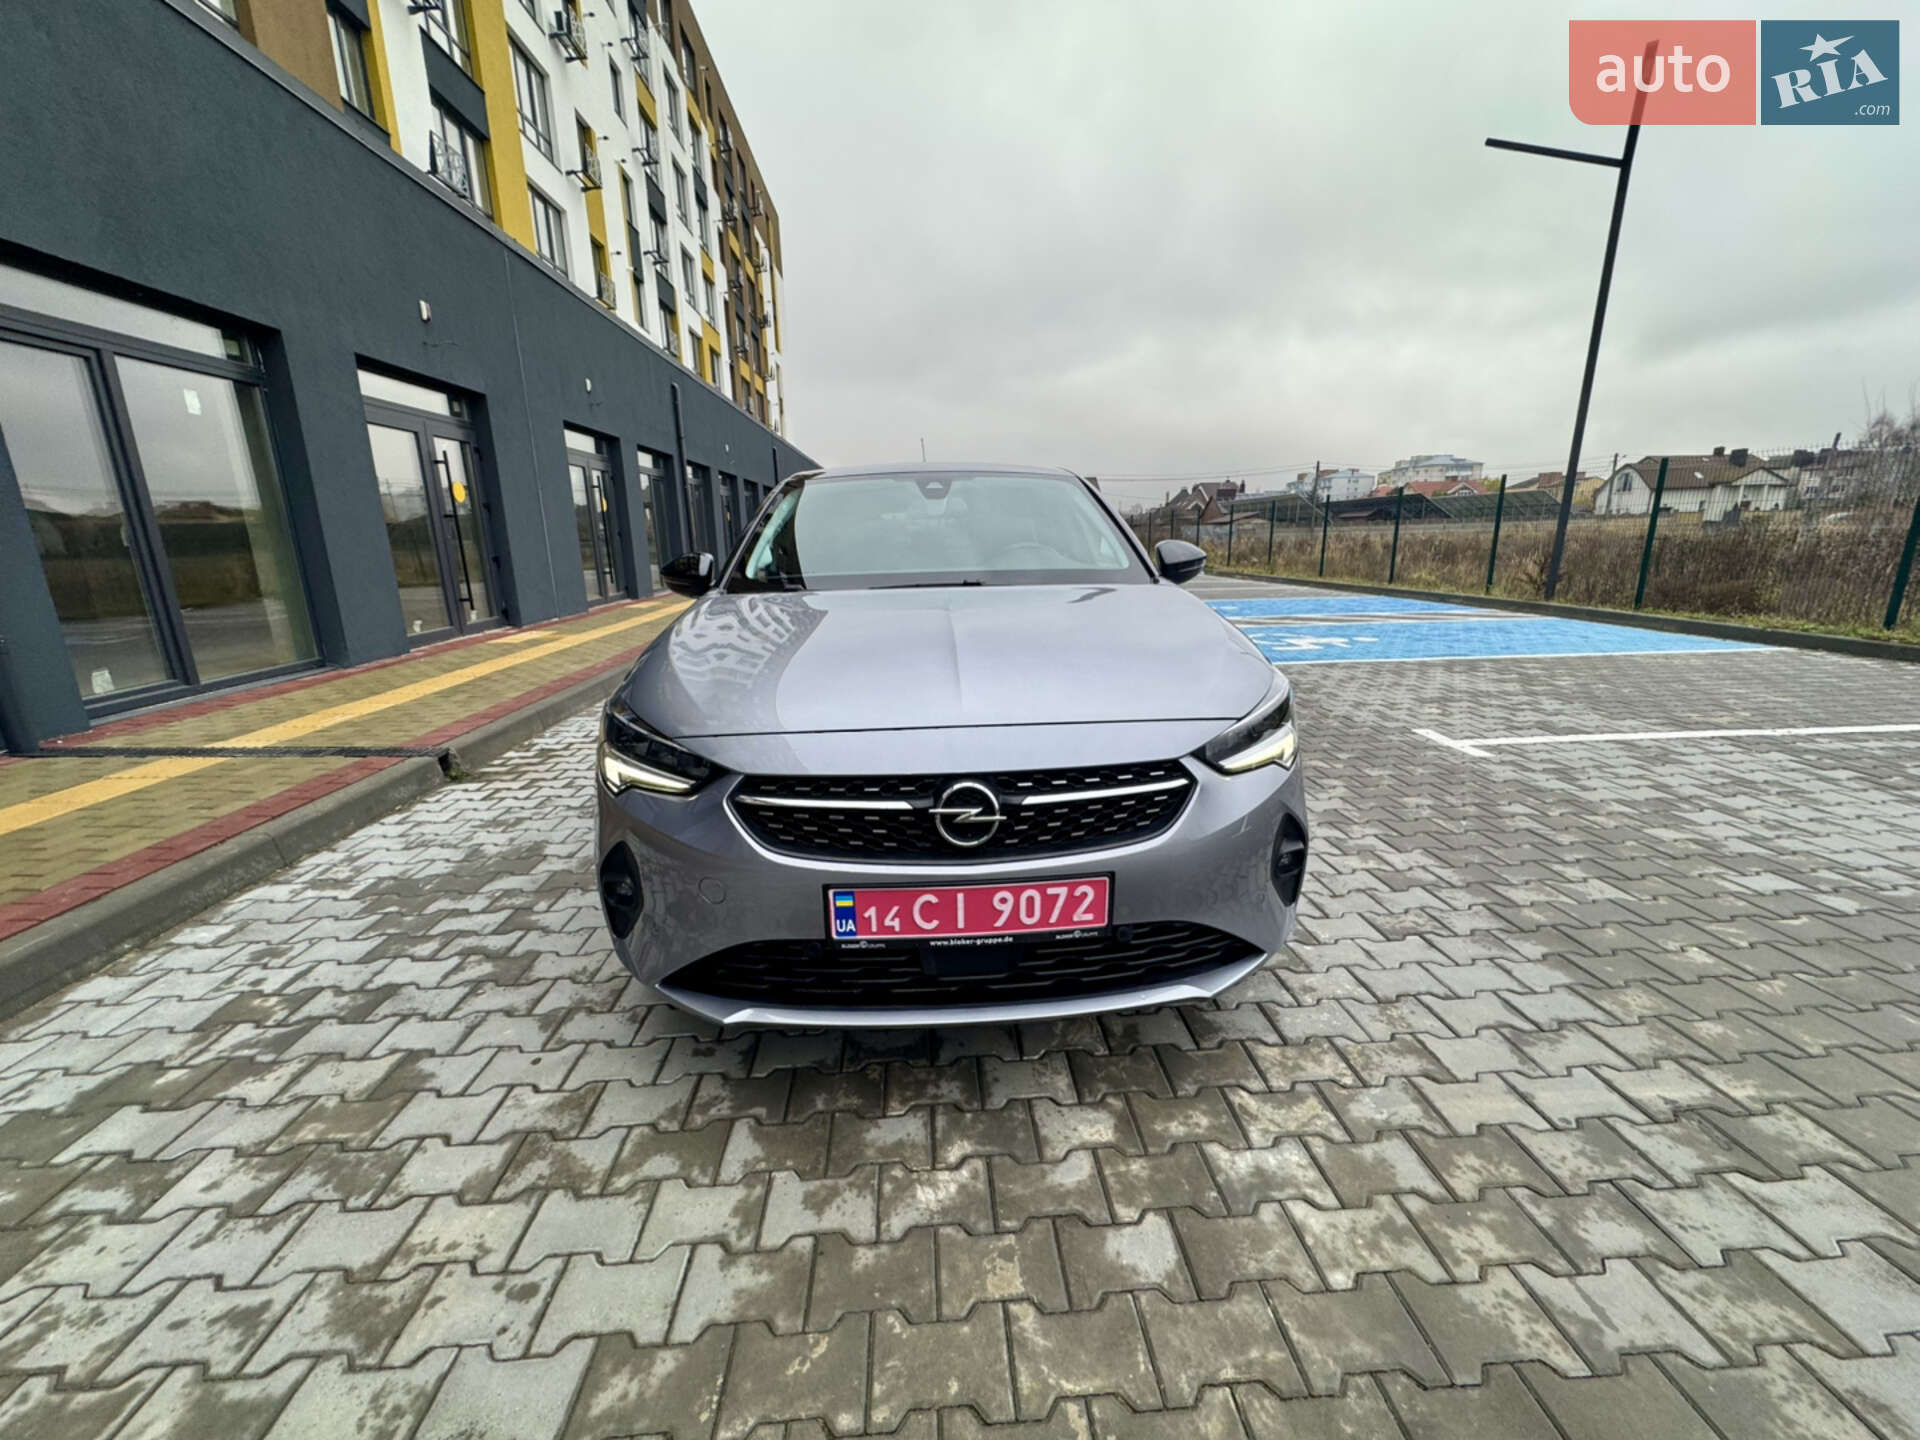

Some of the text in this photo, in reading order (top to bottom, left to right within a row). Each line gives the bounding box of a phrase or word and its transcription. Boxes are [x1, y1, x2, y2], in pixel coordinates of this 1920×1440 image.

[863, 905, 901, 932] 14
[991, 885, 1096, 928] 9072
[836, 919, 856, 932] UA
